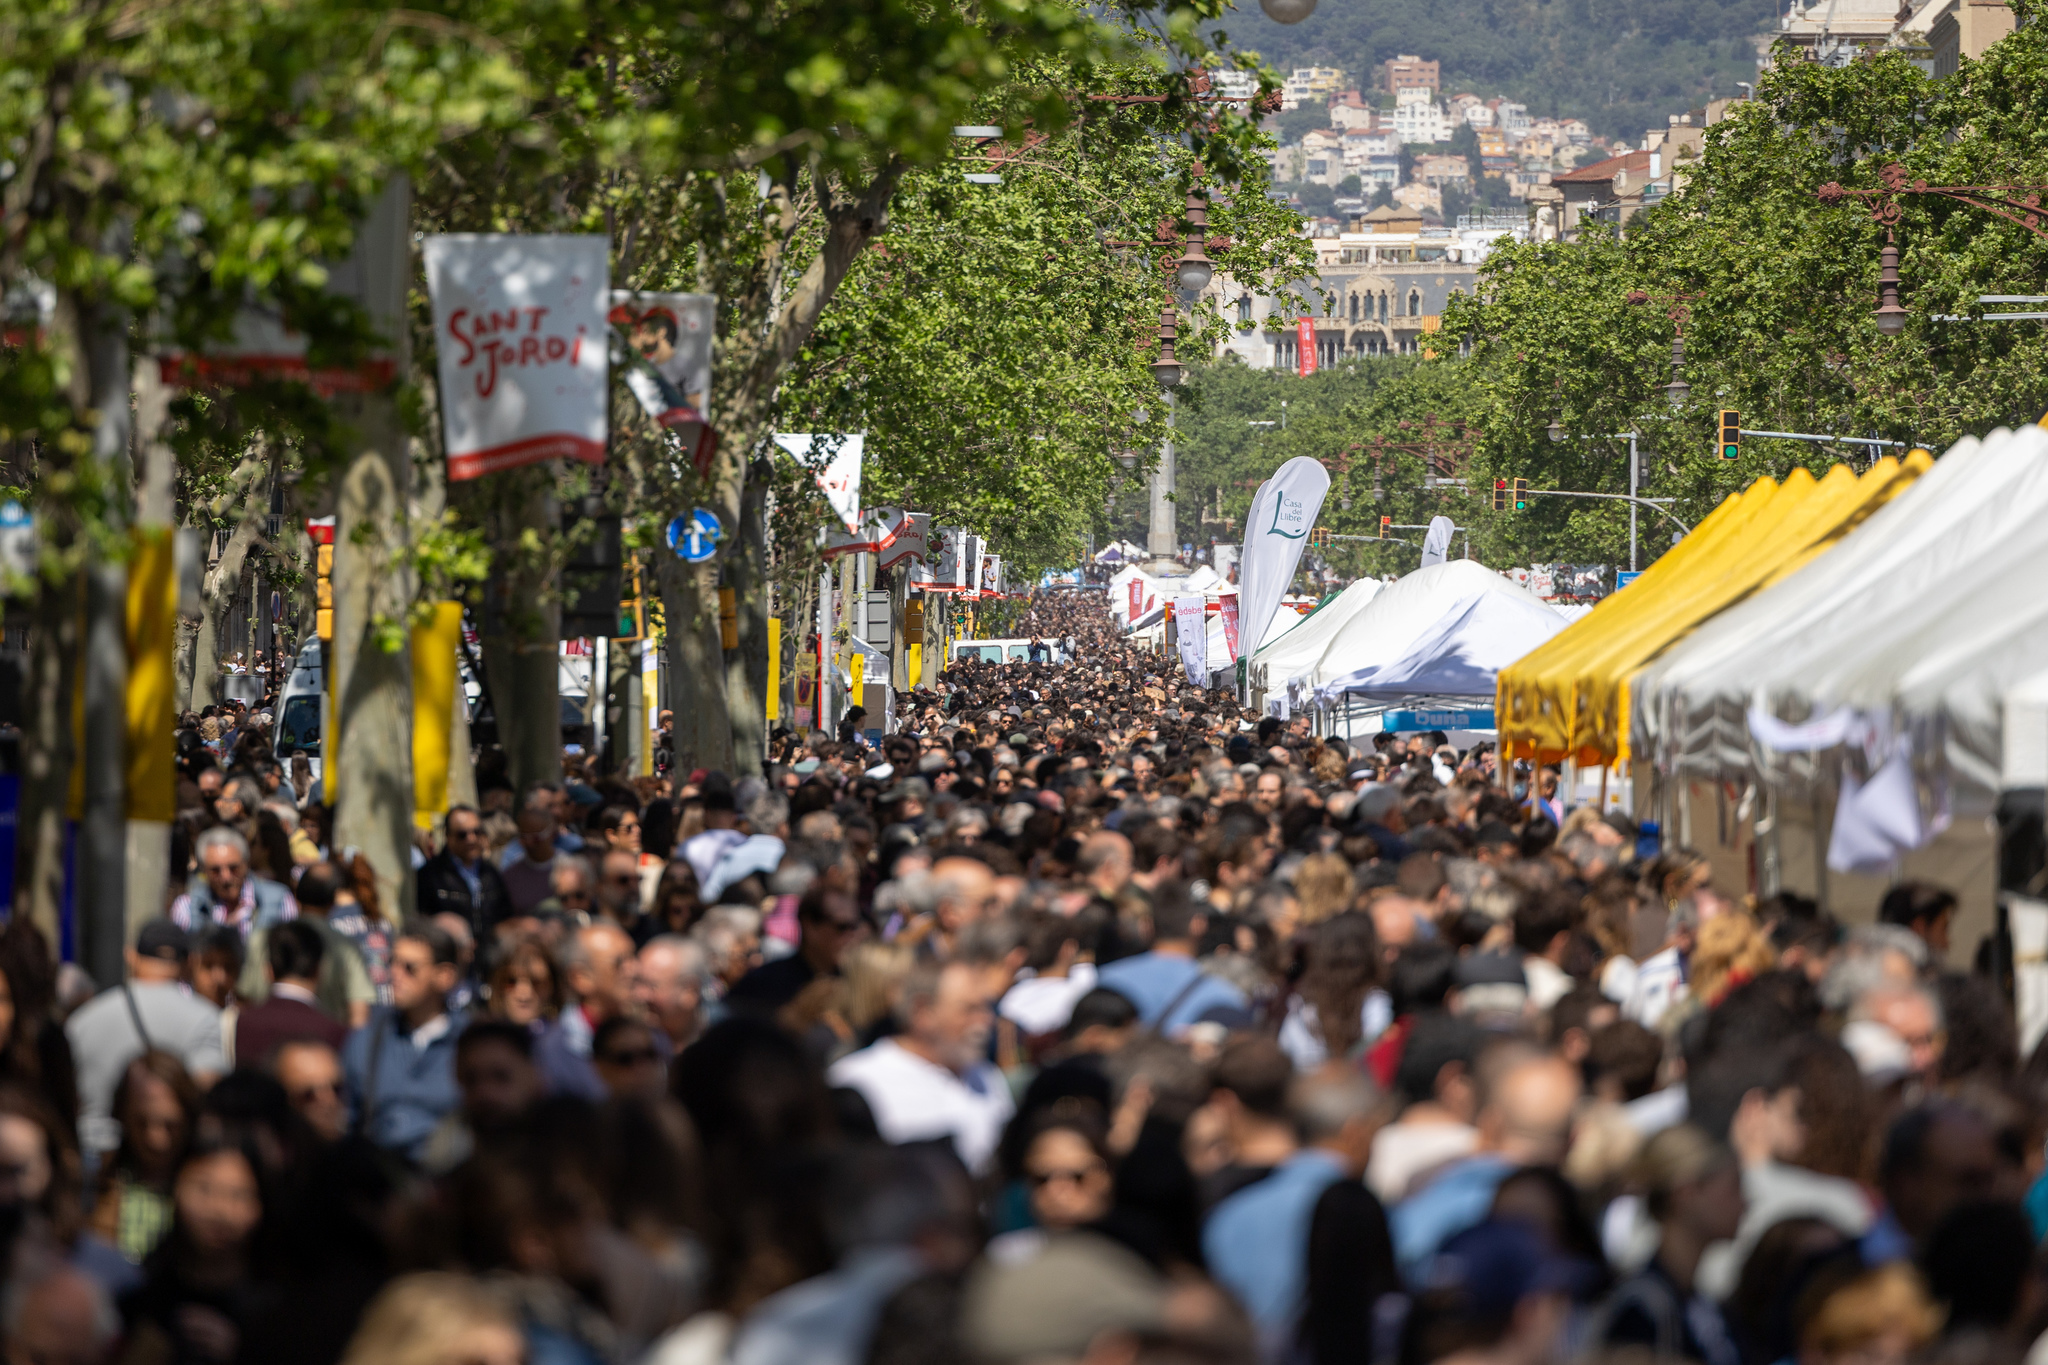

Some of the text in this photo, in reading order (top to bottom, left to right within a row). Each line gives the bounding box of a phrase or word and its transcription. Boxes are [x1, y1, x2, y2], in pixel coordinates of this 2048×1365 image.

[447, 308, 550, 366] SANT
[1284, 499, 1302, 508] Casa
[1280, 512, 1302, 522] Llibre
